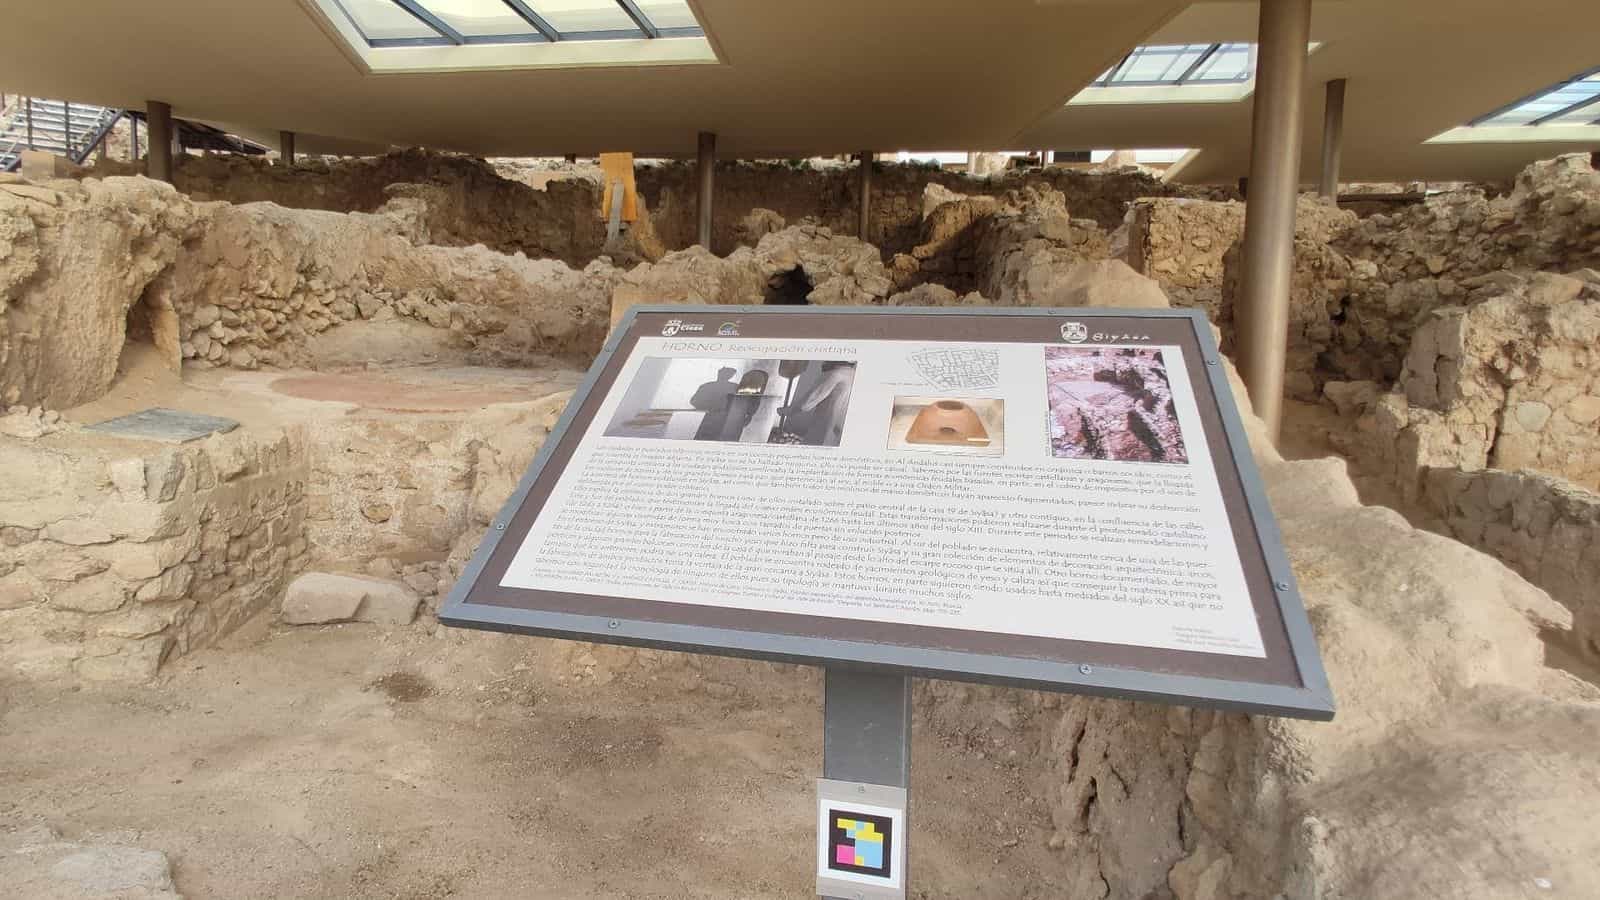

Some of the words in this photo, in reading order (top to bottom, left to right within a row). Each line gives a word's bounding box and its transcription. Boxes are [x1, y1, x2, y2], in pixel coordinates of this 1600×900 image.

[945, 524, 965, 533] siglo
[1052, 581, 1068, 589] que
[1038, 588, 1062, 597] hasta
[1112, 594, 1126, 602] del
